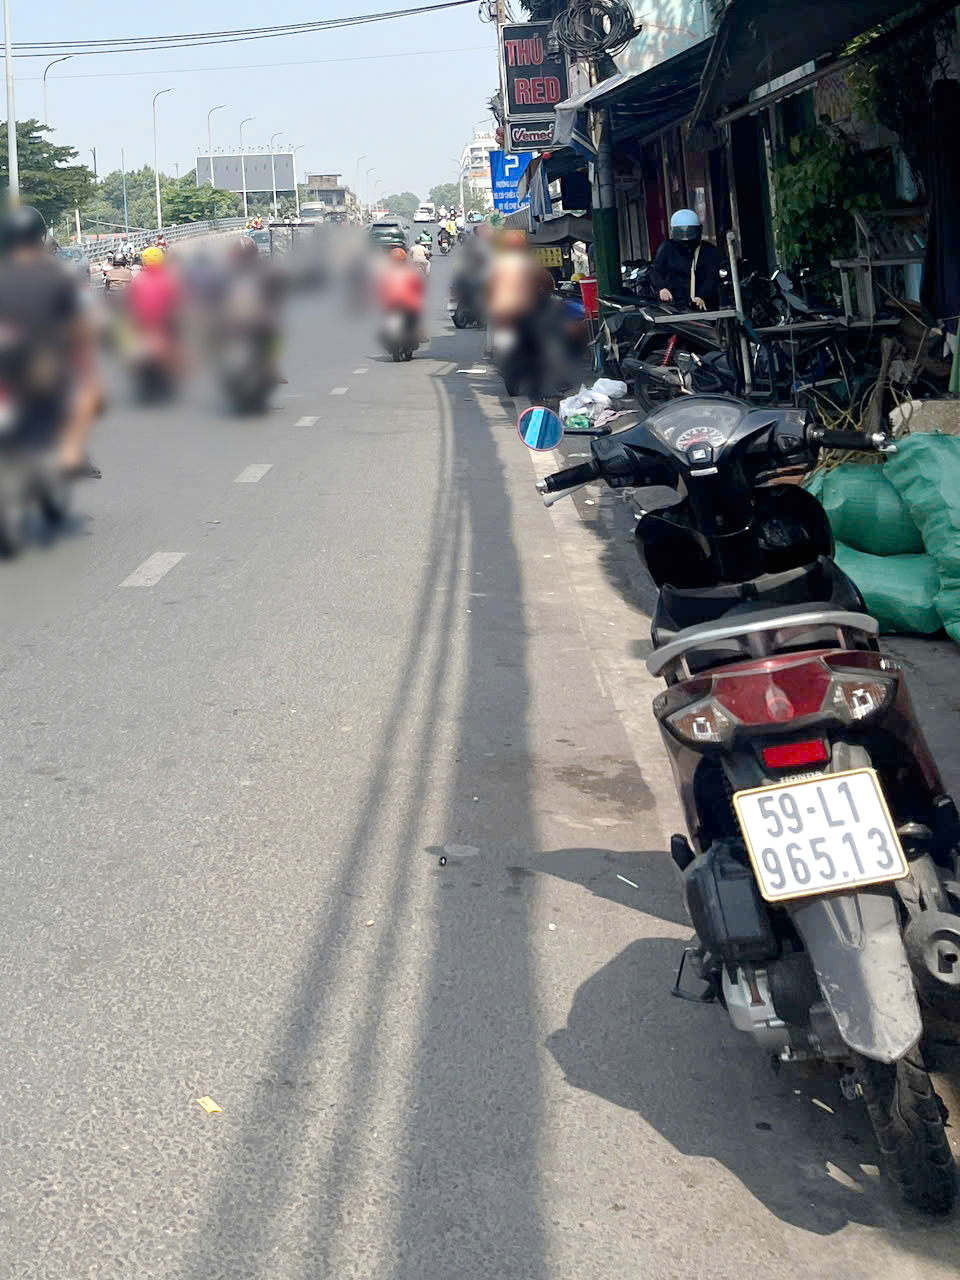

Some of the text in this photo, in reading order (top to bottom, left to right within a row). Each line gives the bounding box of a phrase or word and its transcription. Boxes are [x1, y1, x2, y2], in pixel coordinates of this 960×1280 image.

[514, 76, 561, 104] RED
[779, 771, 824, 783] HONDA
[757, 781, 860, 838] 59-L1
[761, 827, 894, 890] 965.13
